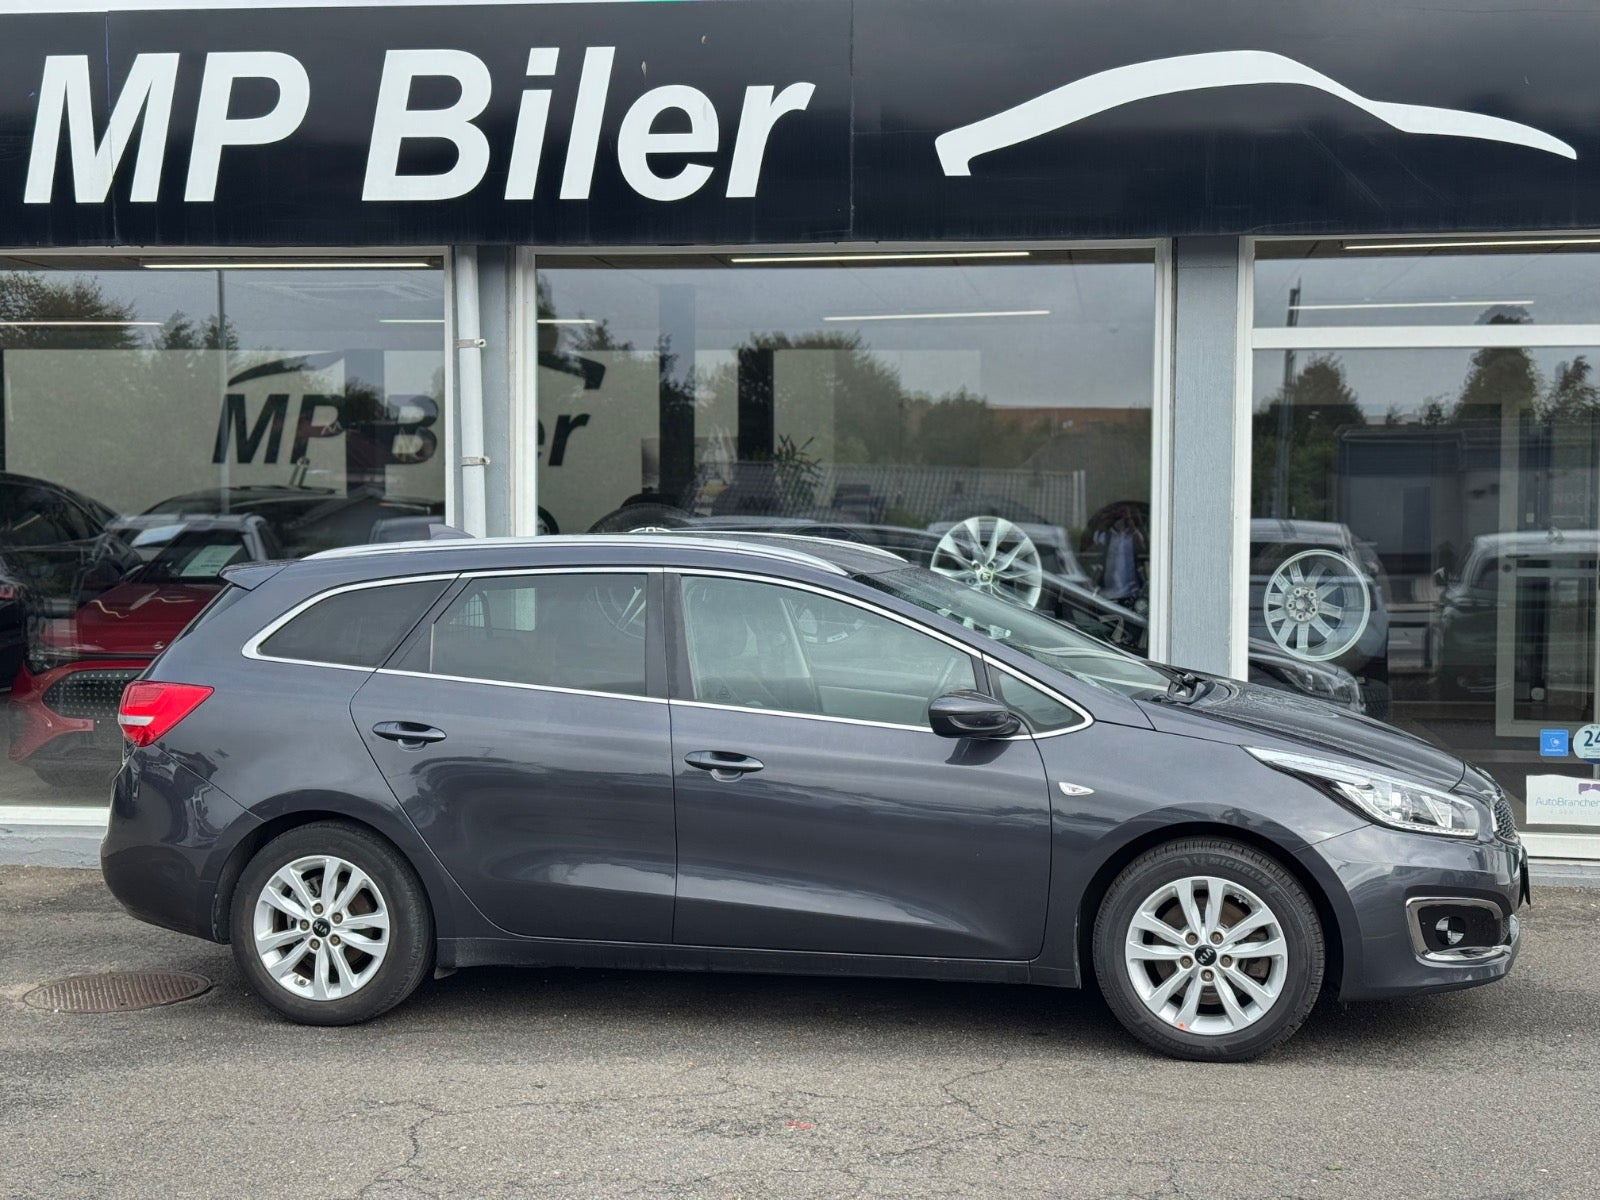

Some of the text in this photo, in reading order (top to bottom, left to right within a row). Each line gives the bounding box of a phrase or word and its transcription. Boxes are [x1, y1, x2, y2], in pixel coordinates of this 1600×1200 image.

[24, 46, 816, 204] MP Biler
[212, 393, 346, 465] MP
[1535, 797, 1600, 807] AutoBranche
[314, 921, 327, 935] KIA
[1198, 948, 1214, 964] KIA
